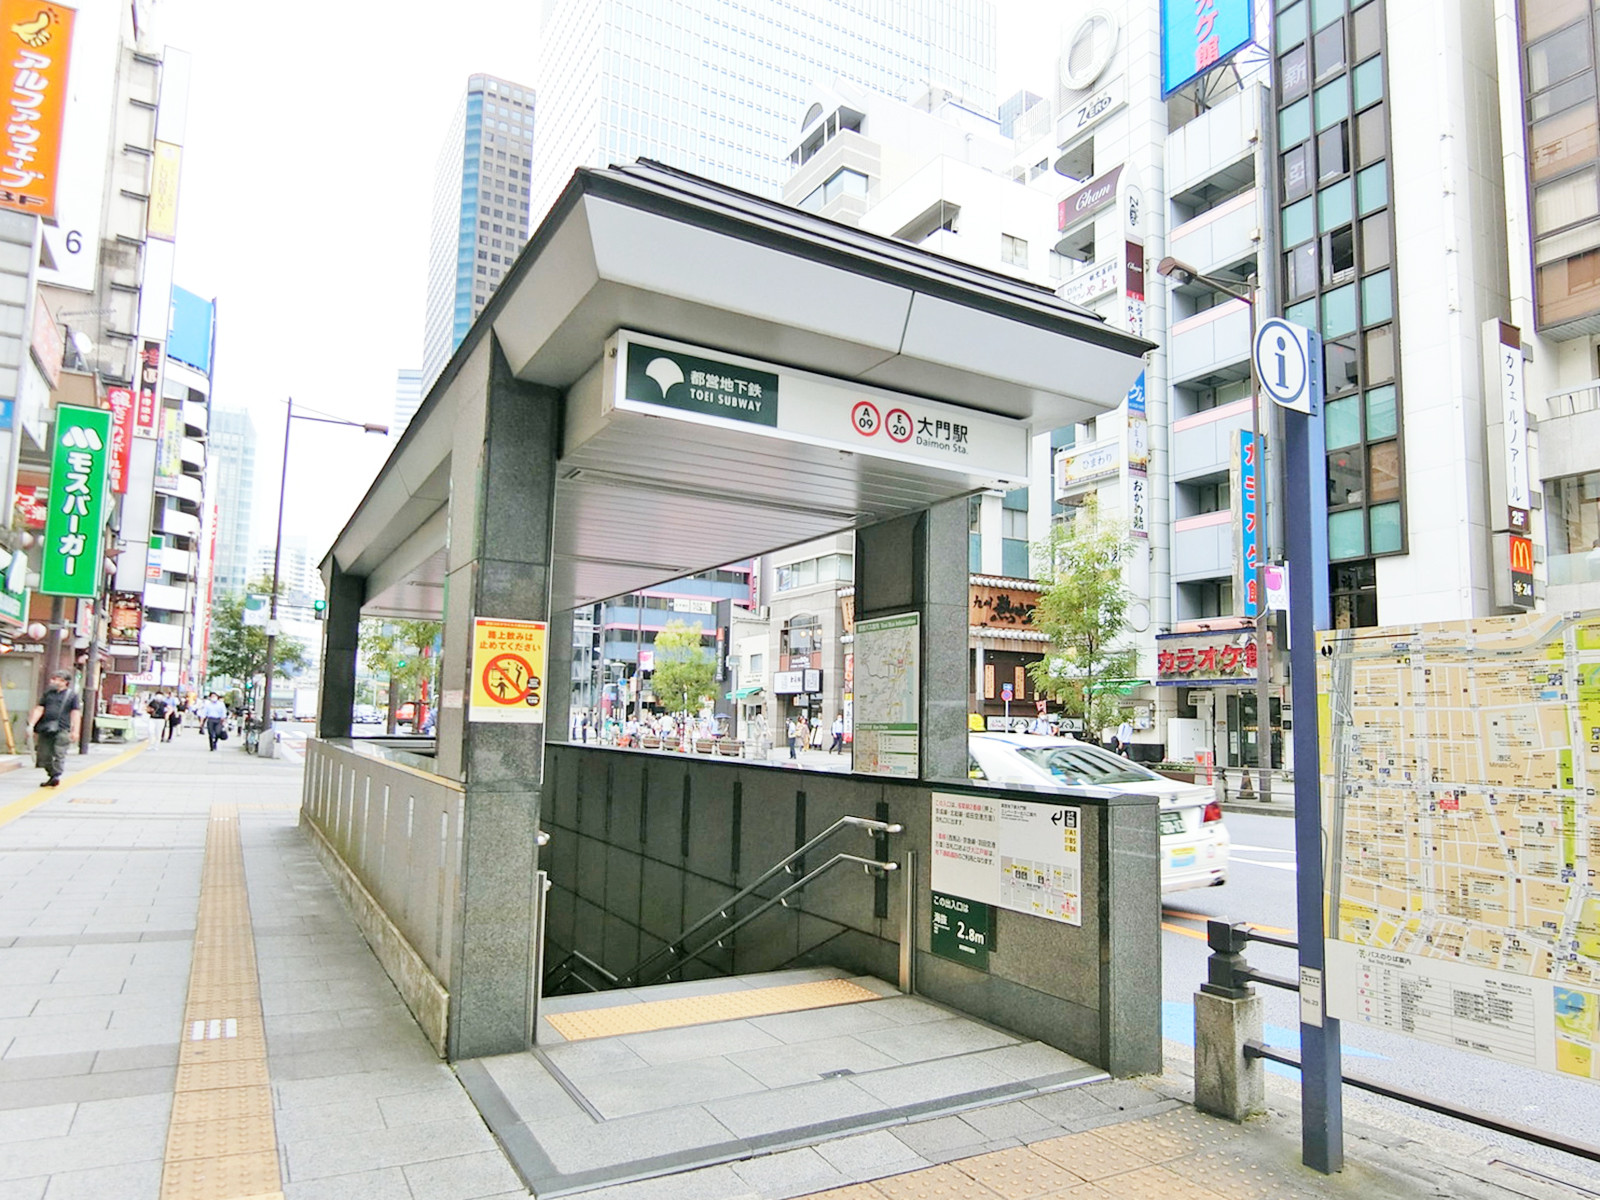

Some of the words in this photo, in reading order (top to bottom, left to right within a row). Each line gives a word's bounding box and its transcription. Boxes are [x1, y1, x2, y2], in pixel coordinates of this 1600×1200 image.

[65, 229, 83, 254] 6
[690, 370, 762, 398] 都営地下鉄
[690, 388, 714, 403] TOEI
[718, 393, 762, 412] SUBWAY
[862, 407, 871, 417] A
[897, 414, 903, 424] E
[858, 417, 874, 430] 09
[892, 424, 907, 437] 20
[917, 416, 969, 444] 大門駅
[916, 435, 950, 451] Daimon
[953, 442, 969, 455] Sta.
[59, 450, 93, 576] モスバーガー
[1511, 510, 1525, 526] 2F
[479, 640, 541, 652] 止めてください
[933, 895, 970, 913] この出入口は
[957, 921, 985, 945] 2.8m
